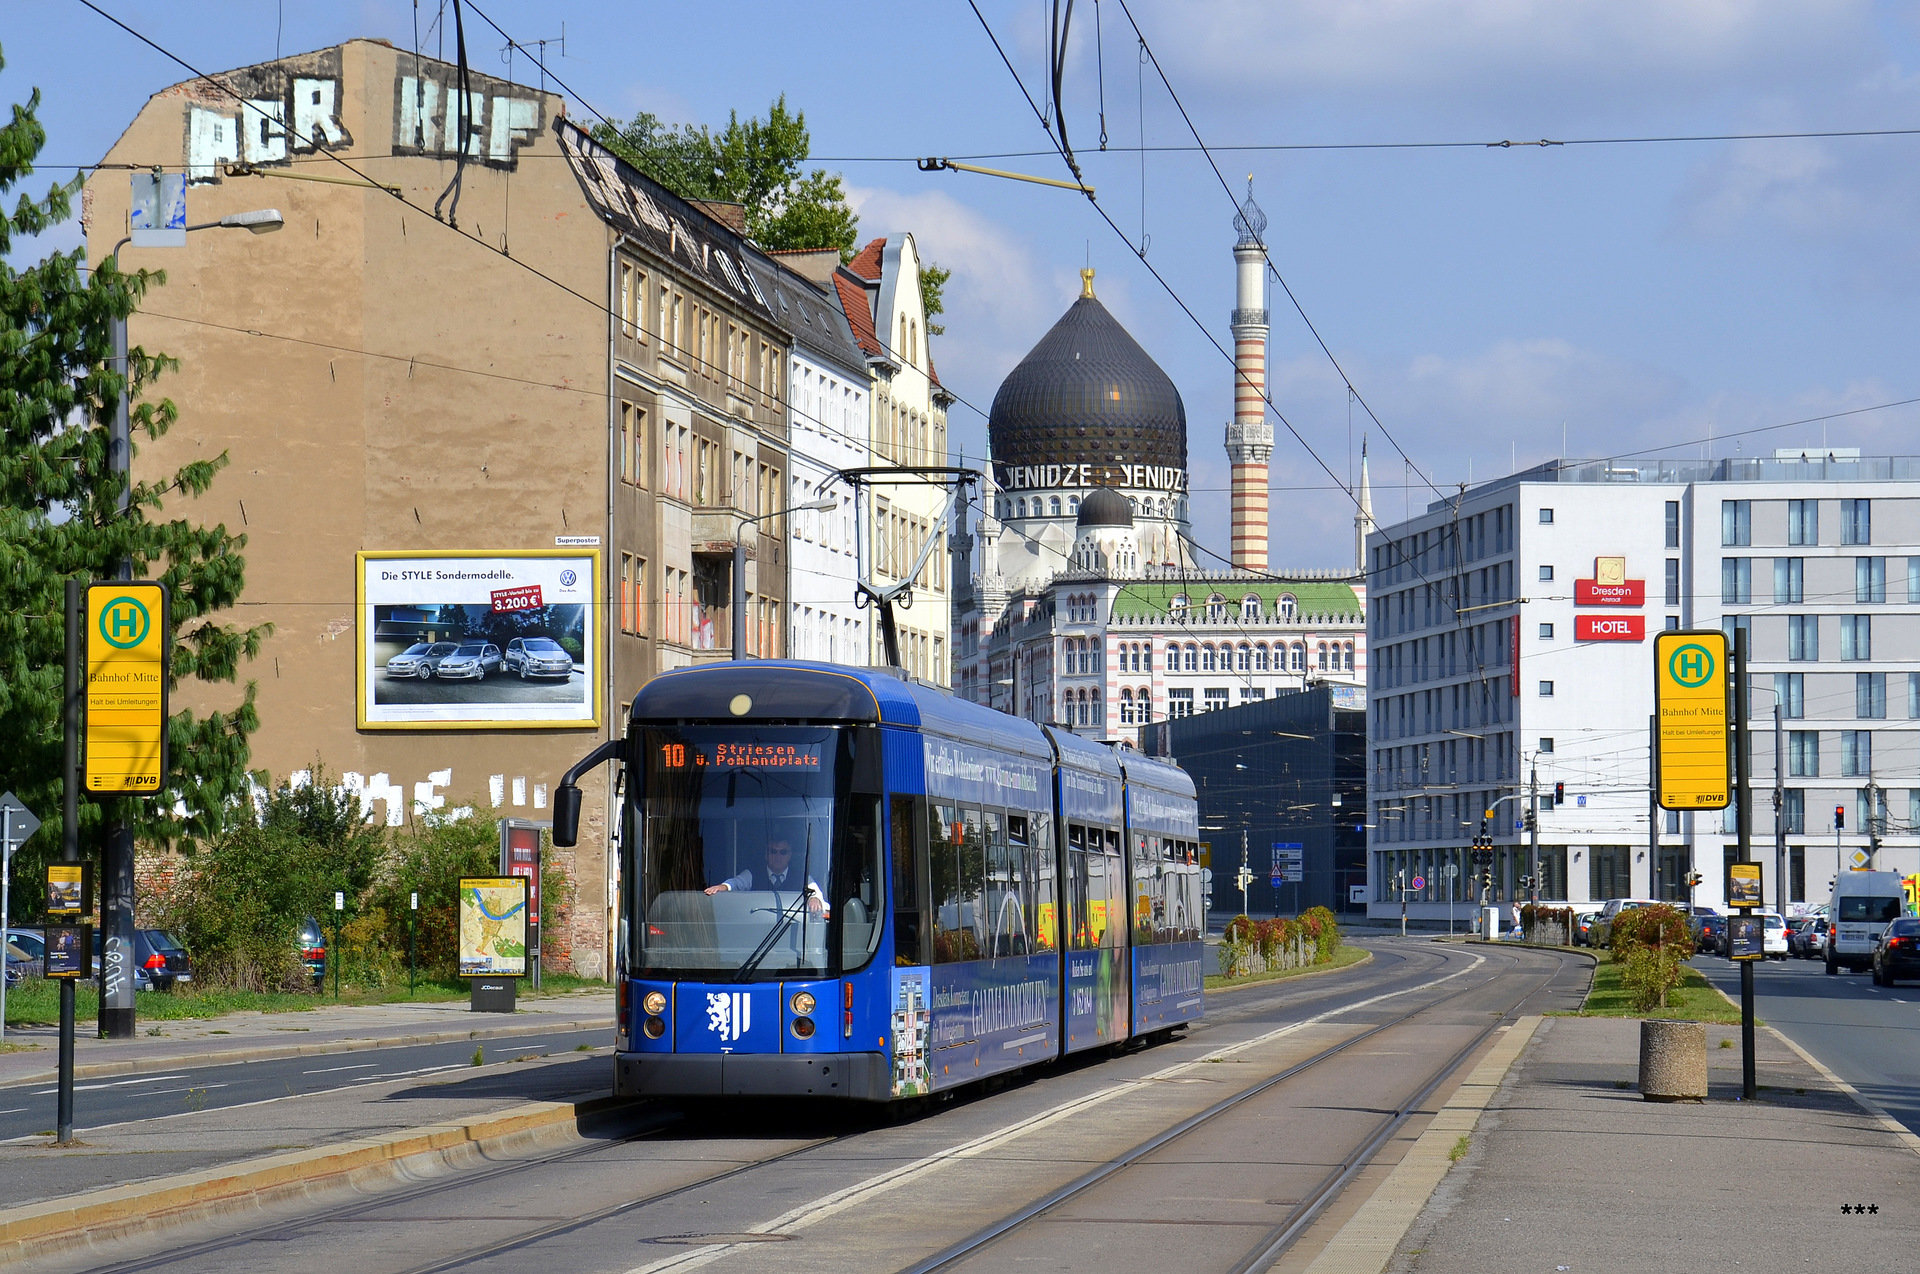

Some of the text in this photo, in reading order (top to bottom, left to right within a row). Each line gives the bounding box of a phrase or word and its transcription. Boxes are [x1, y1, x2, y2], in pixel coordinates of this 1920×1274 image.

[1005, 464, 1092, 489] YENIDZE
[557, 537, 598, 545] Superposter
[381, 569, 514, 580] Die STYLE Sondermodelle.
[1591, 586, 1632, 596] Dresden
[494, 596, 528, 611] 3.200
[1592, 621, 1631, 634] HOTEL
[90, 672, 159, 683] Bahnhof Mitte
[90, 698, 158, 707] Halt bei Umleitungen
[1662, 707, 1724, 717] Bahnhof Mitte
[1686, 729, 1723, 737] Umleitungen
[717, 743, 796, 755] Striesen
[661, 743, 686, 768] 10
[716, 754, 819, 767] Pohlandplatz
[135, 776, 157, 785] DVB
[1704, 794, 1725, 802] DVB
